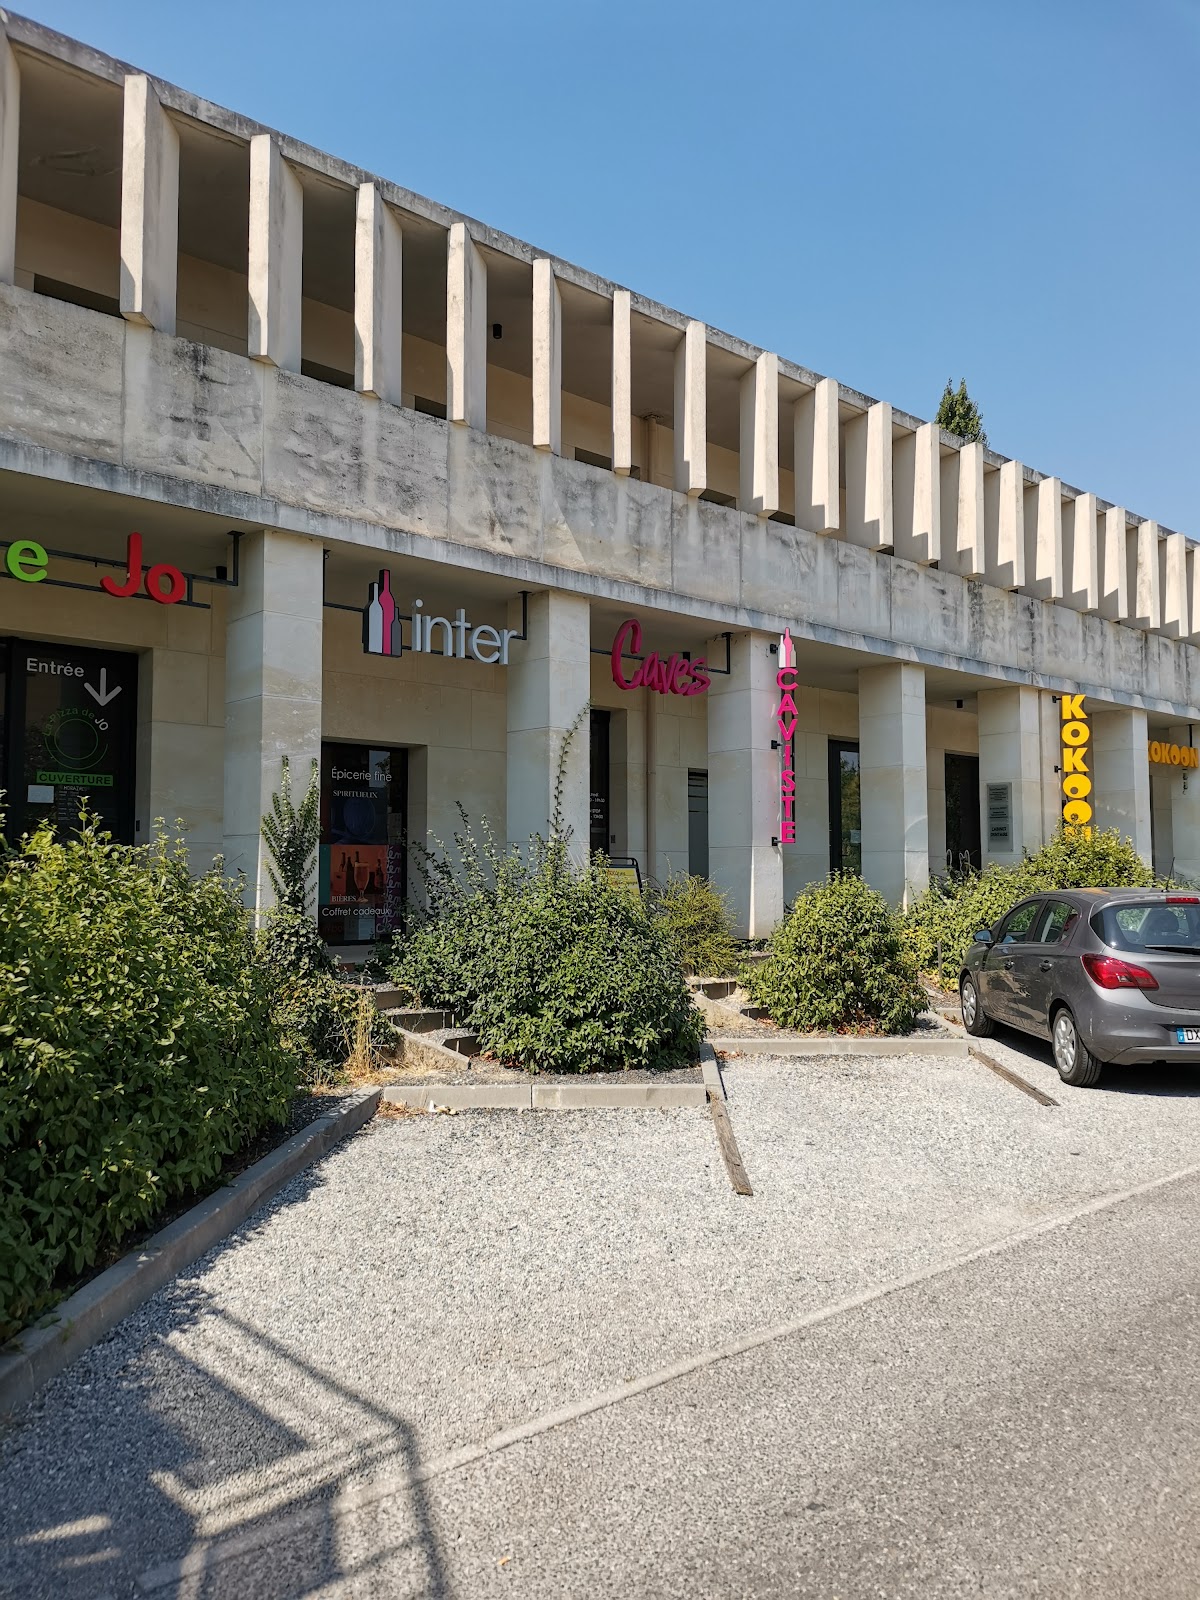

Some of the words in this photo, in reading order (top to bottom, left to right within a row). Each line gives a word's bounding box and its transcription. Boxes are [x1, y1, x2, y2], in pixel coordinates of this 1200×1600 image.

[100, 531, 186, 604] Jo
[411, 598, 518, 665] inter
[611, 618, 711, 696] Caves
[26, 657, 85, 677] Entrée
[81, 708, 95, 719] de
[776, 668, 799, 844] CAVISTE
[39, 773, 111, 785] OUVERTURE
[331, 766, 372, 780] Épicerie
[374, 770, 392, 782] fine
[332, 790, 378, 799] SPIRITUEUX
[331, 894, 357, 902] BIÈRES
[322, 907, 352, 917] Coffret
[352, 907, 390, 916] cadeaux
